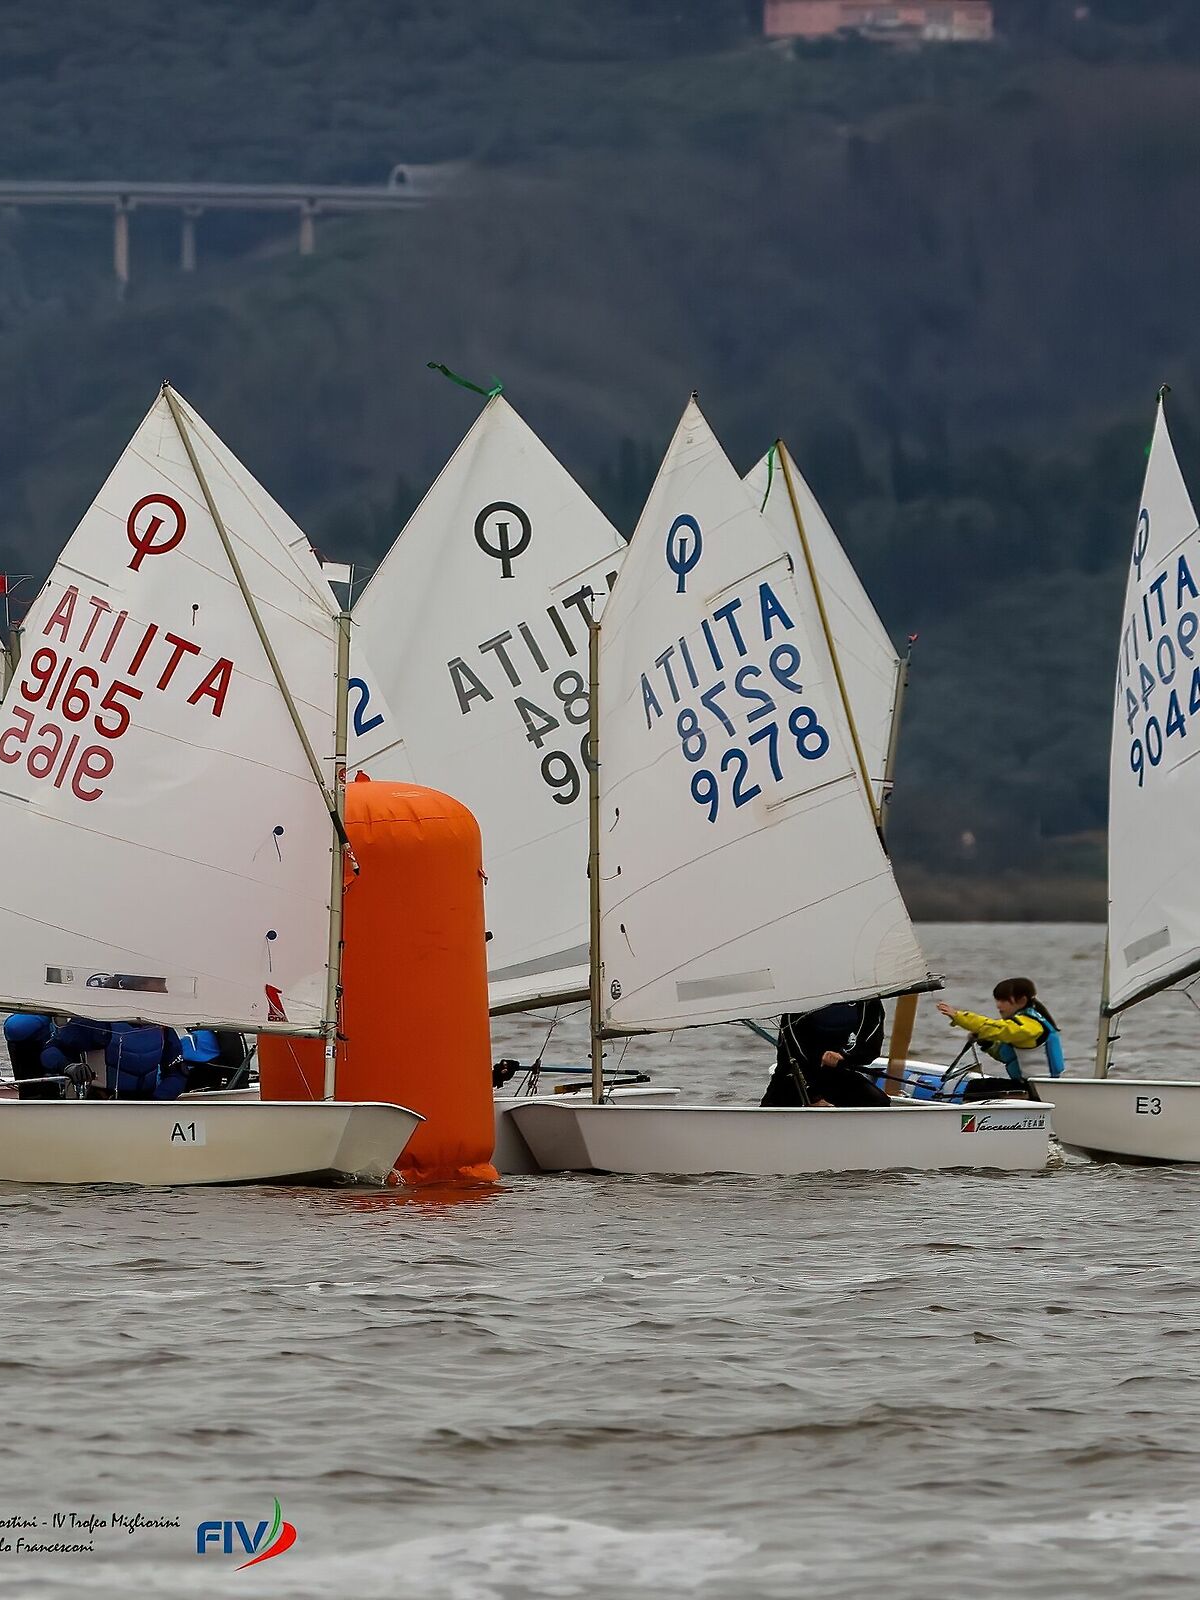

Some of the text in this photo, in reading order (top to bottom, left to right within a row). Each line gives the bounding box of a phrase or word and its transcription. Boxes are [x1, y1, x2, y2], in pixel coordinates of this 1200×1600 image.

[545, 570, 619, 658] IT
[700, 582, 795, 671] ITA
[1142, 554, 1200, 642] ITA
[20, 648, 145, 739] 9165
[127, 622, 234, 718] ITA
[690, 705, 830, 823] 9278
[171, 1121, 198, 1143] A1
[1135, 1096, 1162, 1115] E3
